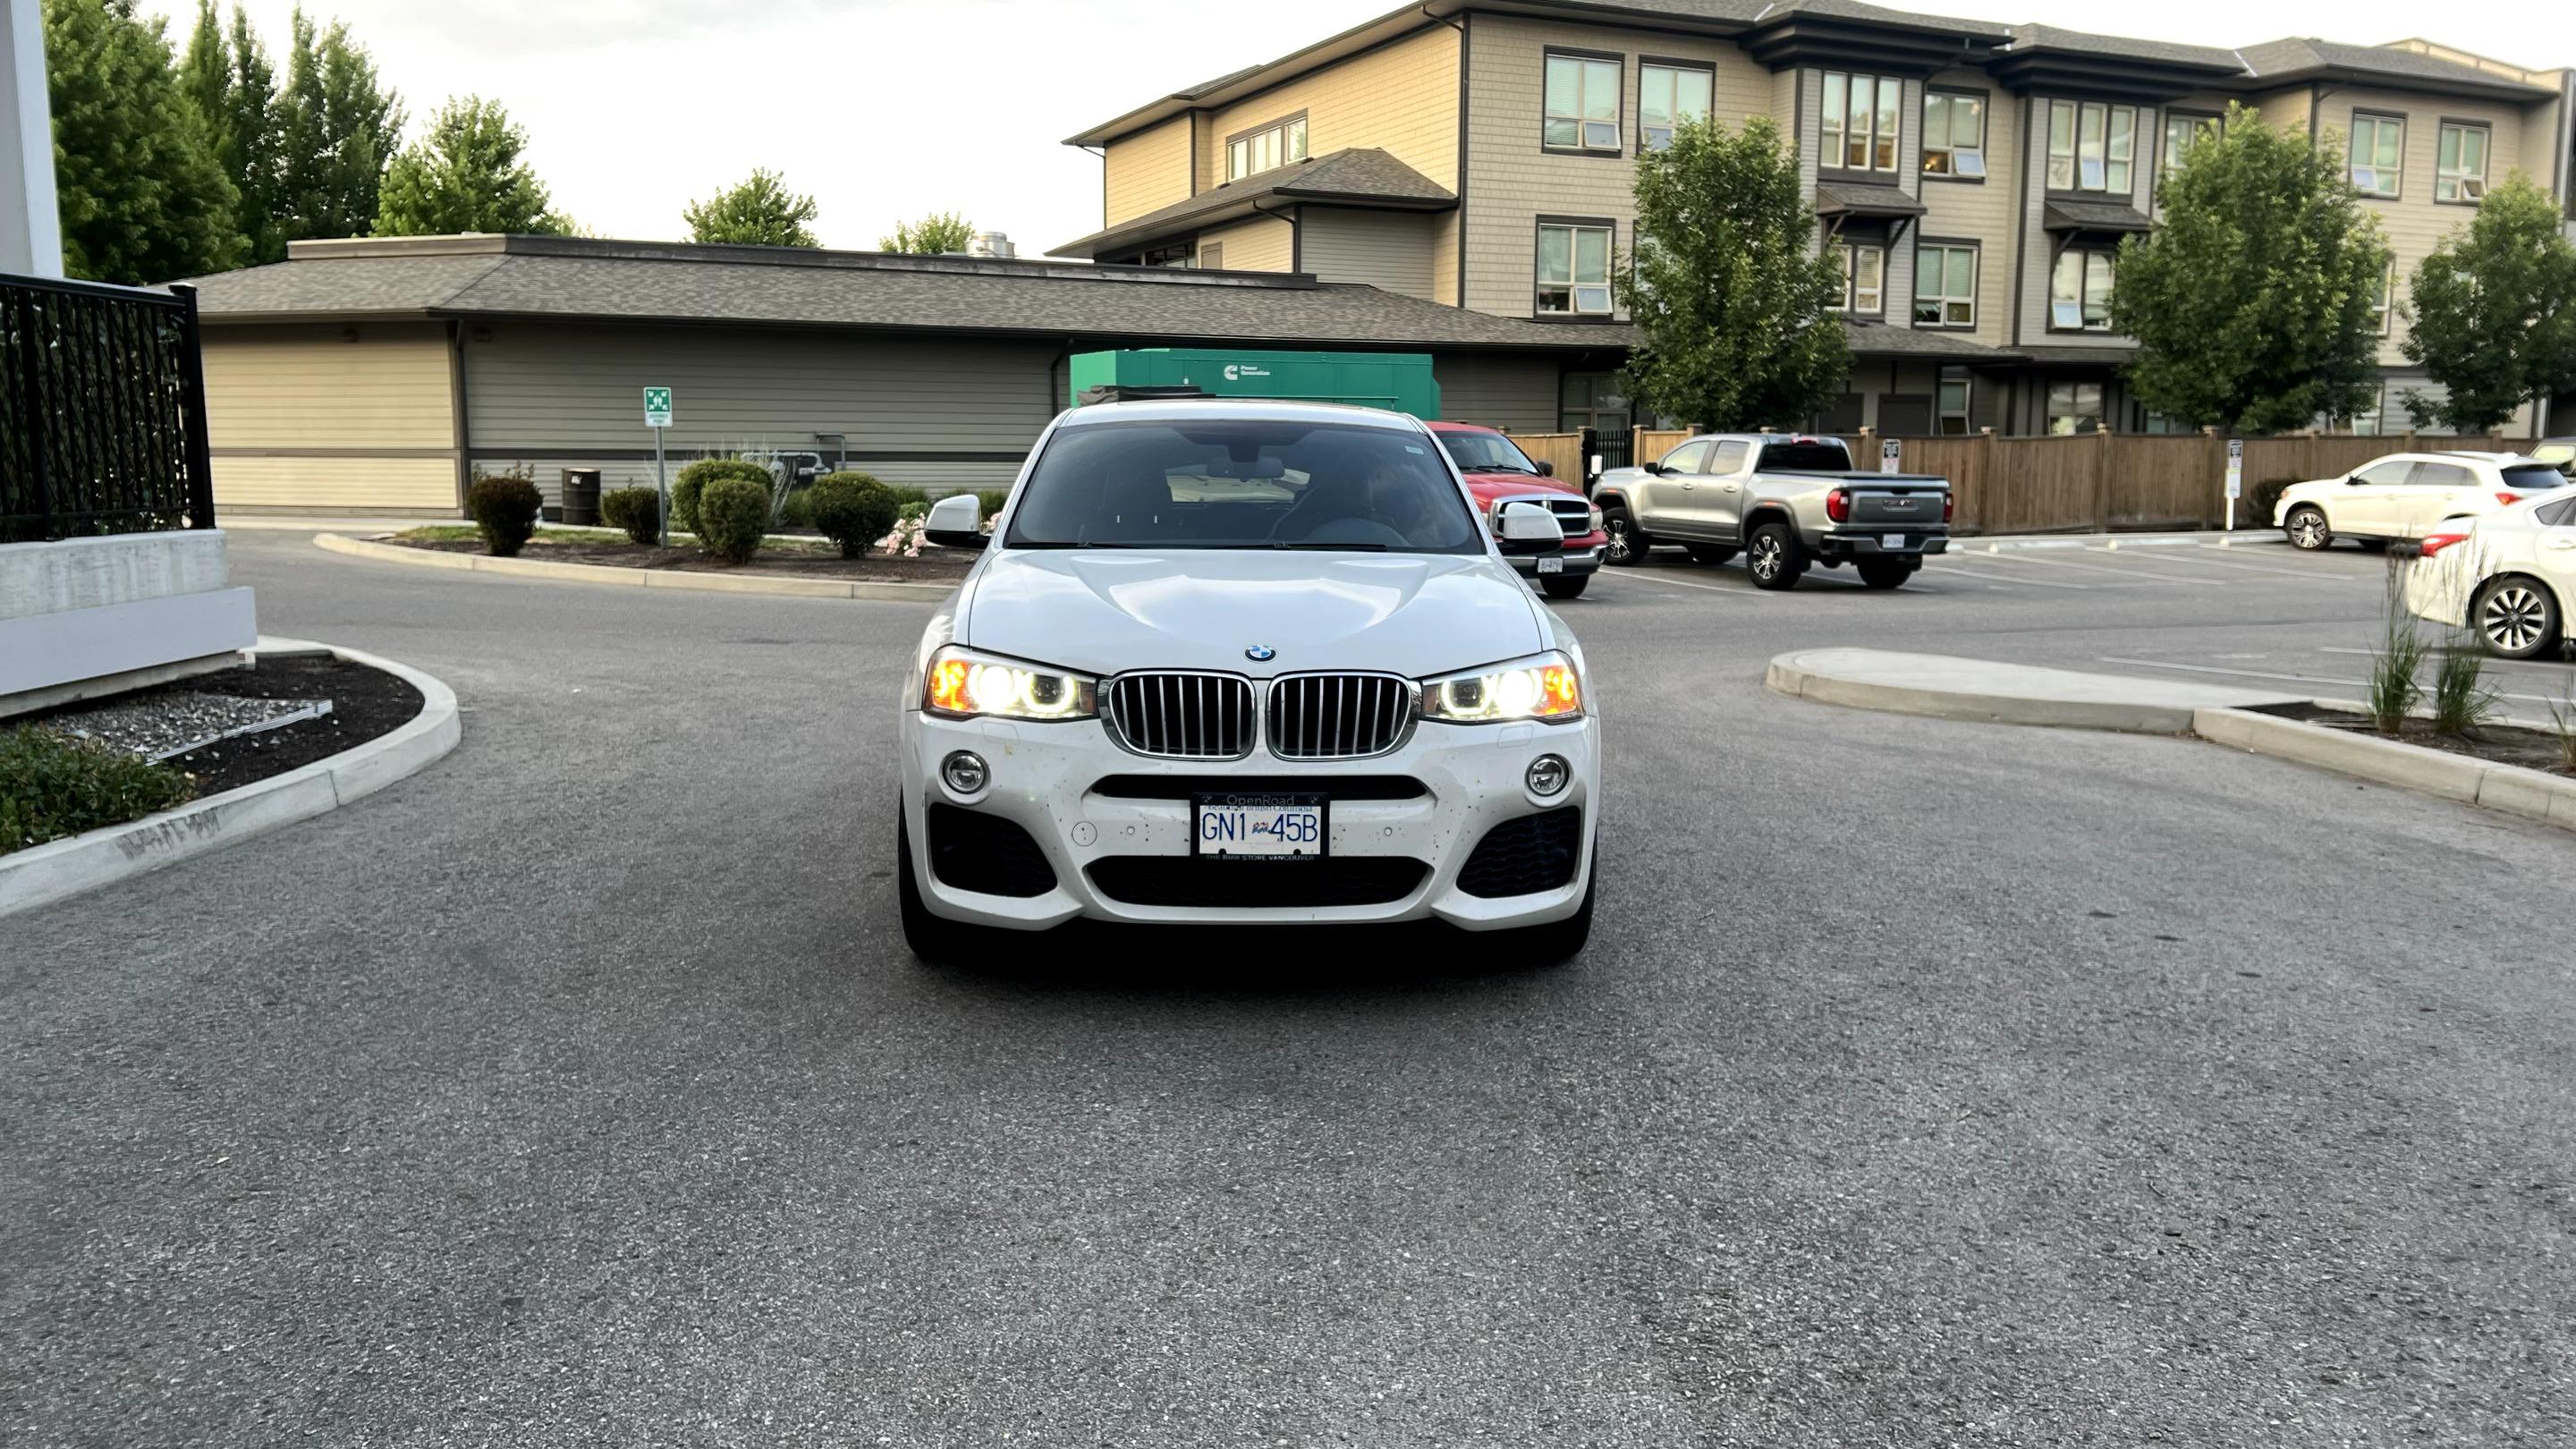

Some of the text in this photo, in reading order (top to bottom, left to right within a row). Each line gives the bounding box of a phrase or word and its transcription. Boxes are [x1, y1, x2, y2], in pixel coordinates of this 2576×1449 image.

[1226, 794, 1294, 806] OpenRoad
[1202, 813, 1318, 842] GN1 45B
